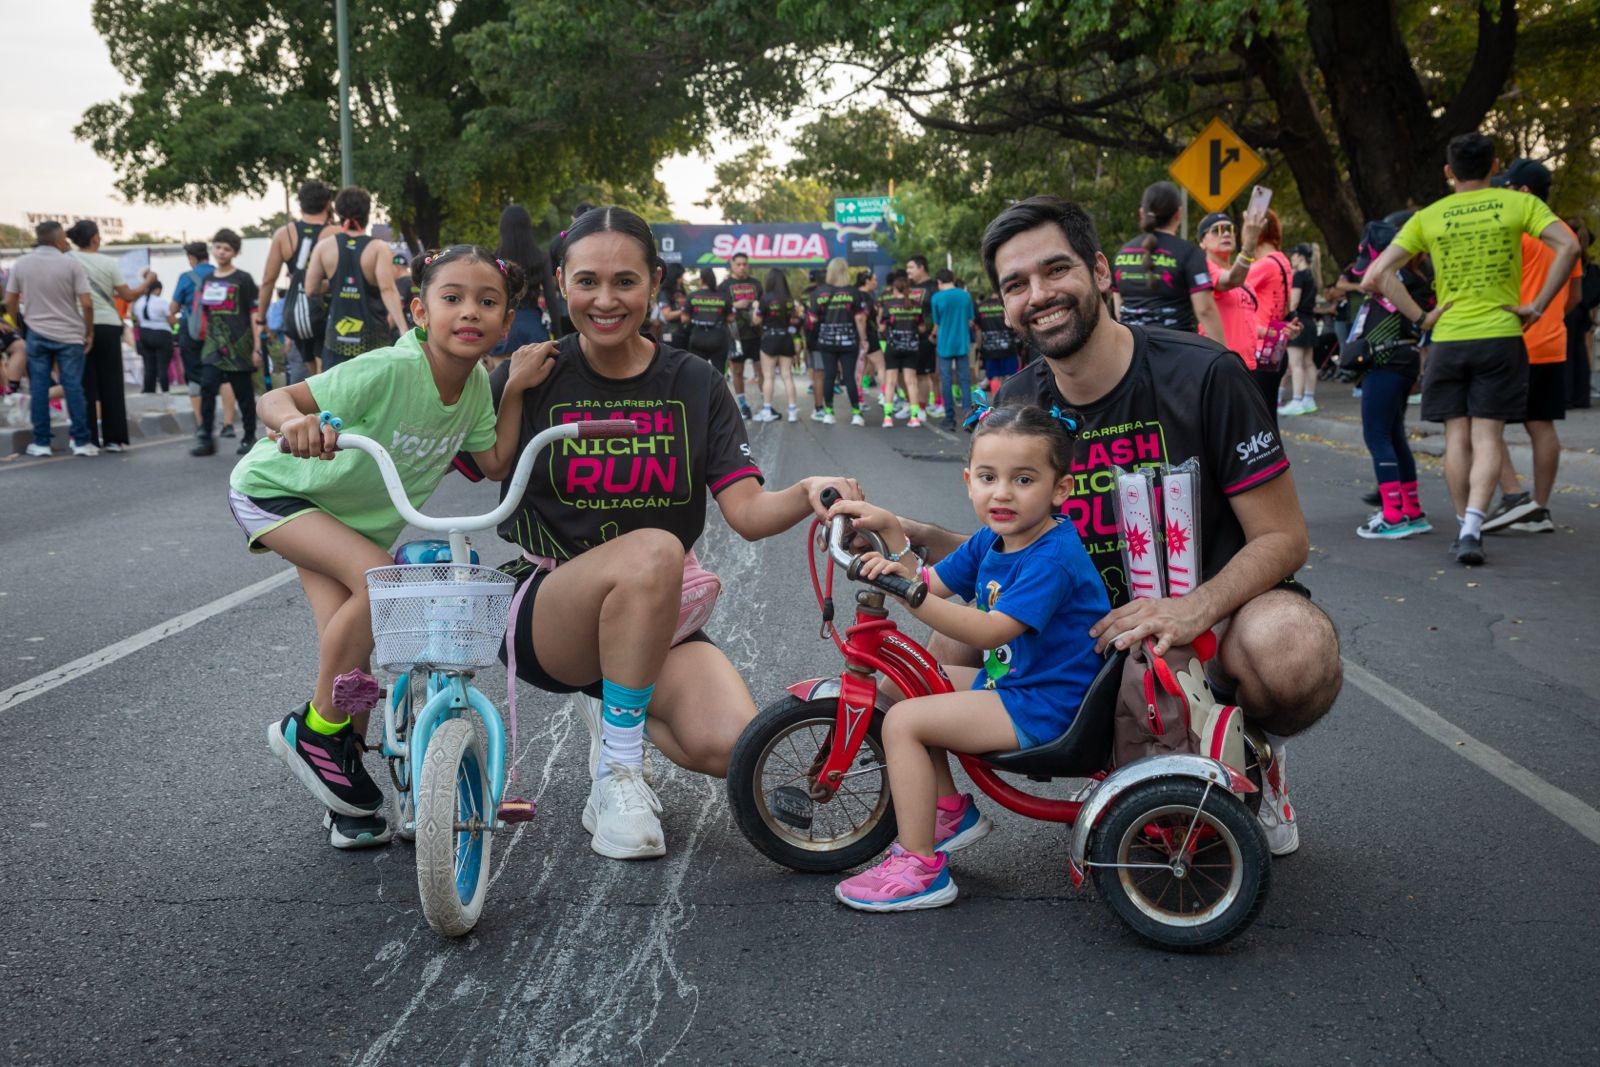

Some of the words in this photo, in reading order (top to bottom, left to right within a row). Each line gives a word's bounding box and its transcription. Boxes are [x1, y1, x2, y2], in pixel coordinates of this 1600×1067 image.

[1443, 202, 1504, 218] CULIACÁN
[712, 233, 824, 257] SALIDA
[1114, 254, 1177, 267] CULICÁN
[576, 400, 600, 408] 1RA
[604, 399, 664, 408] CARRERA
[562, 411, 674, 434] FSH
[1082, 420, 1144, 439] CARRERA
[562, 435, 675, 456] NIGHT
[1071, 432, 1160, 472] LASH
[566, 456, 677, 494] RUN
[575, 495, 670, 510] CULIACÁN
